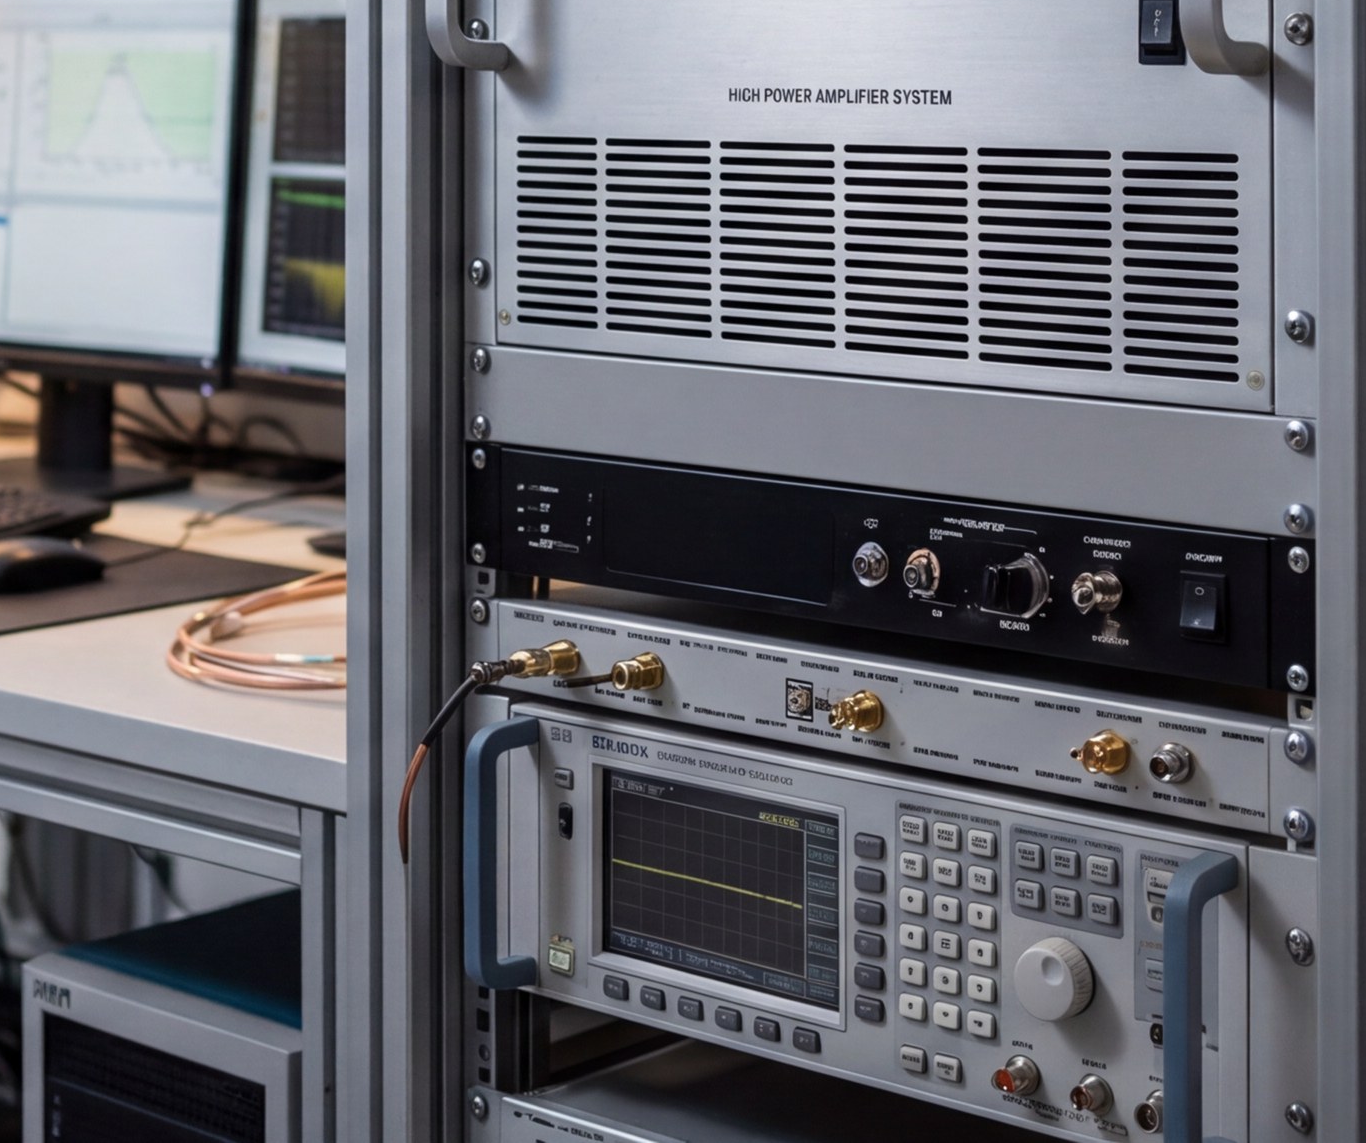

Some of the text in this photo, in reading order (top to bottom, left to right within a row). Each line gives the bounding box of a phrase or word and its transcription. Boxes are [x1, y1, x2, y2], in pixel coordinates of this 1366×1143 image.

[764, 87, 812, 103] POWER
[815, 88, 889, 104] AMPLIFIER
[893, 89, 952, 105] SYSTEM
